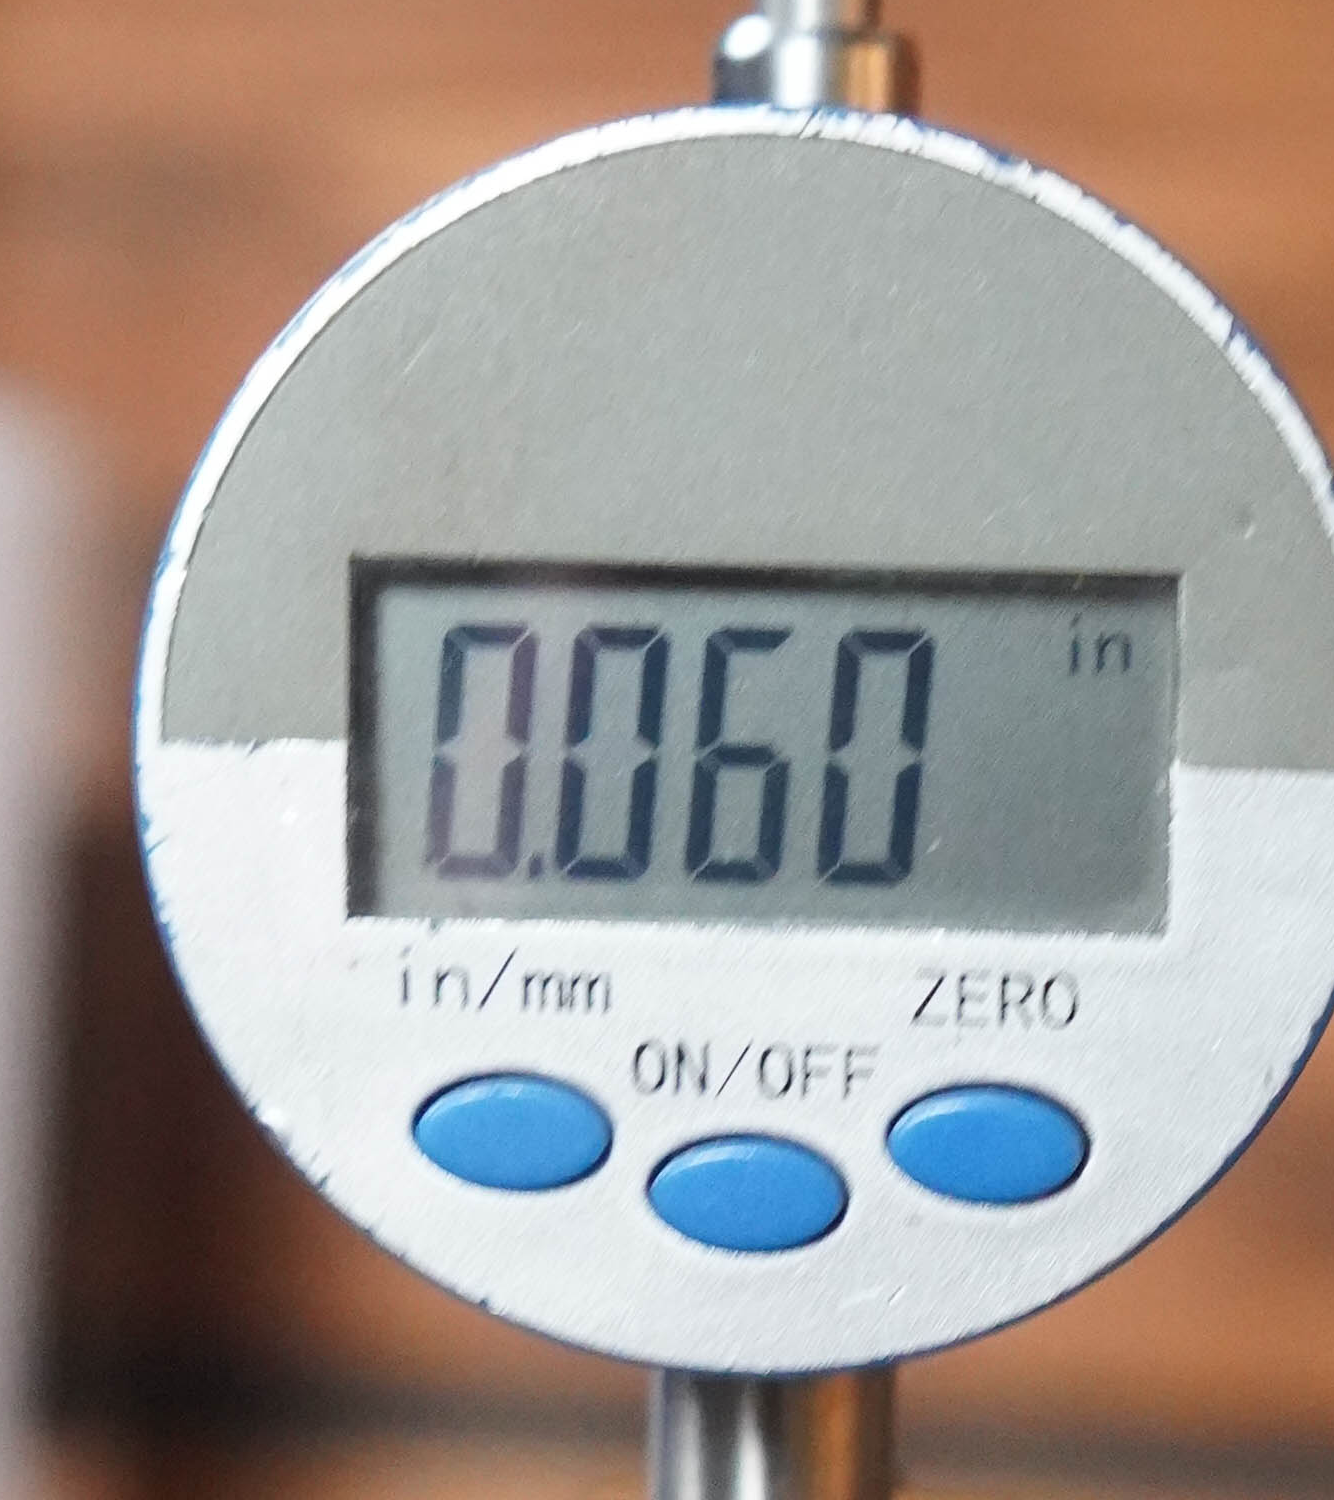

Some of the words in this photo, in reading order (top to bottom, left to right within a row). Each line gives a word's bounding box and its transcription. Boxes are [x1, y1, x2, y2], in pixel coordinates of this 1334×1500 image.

[1069, 614, 1134, 677] in
[424, 621, 936, 887] 0.060
[397, 946, 613, 1015] in/mm
[909, 966, 1081, 1030] ZERO
[630, 1038, 880, 1101] ON/OFF
